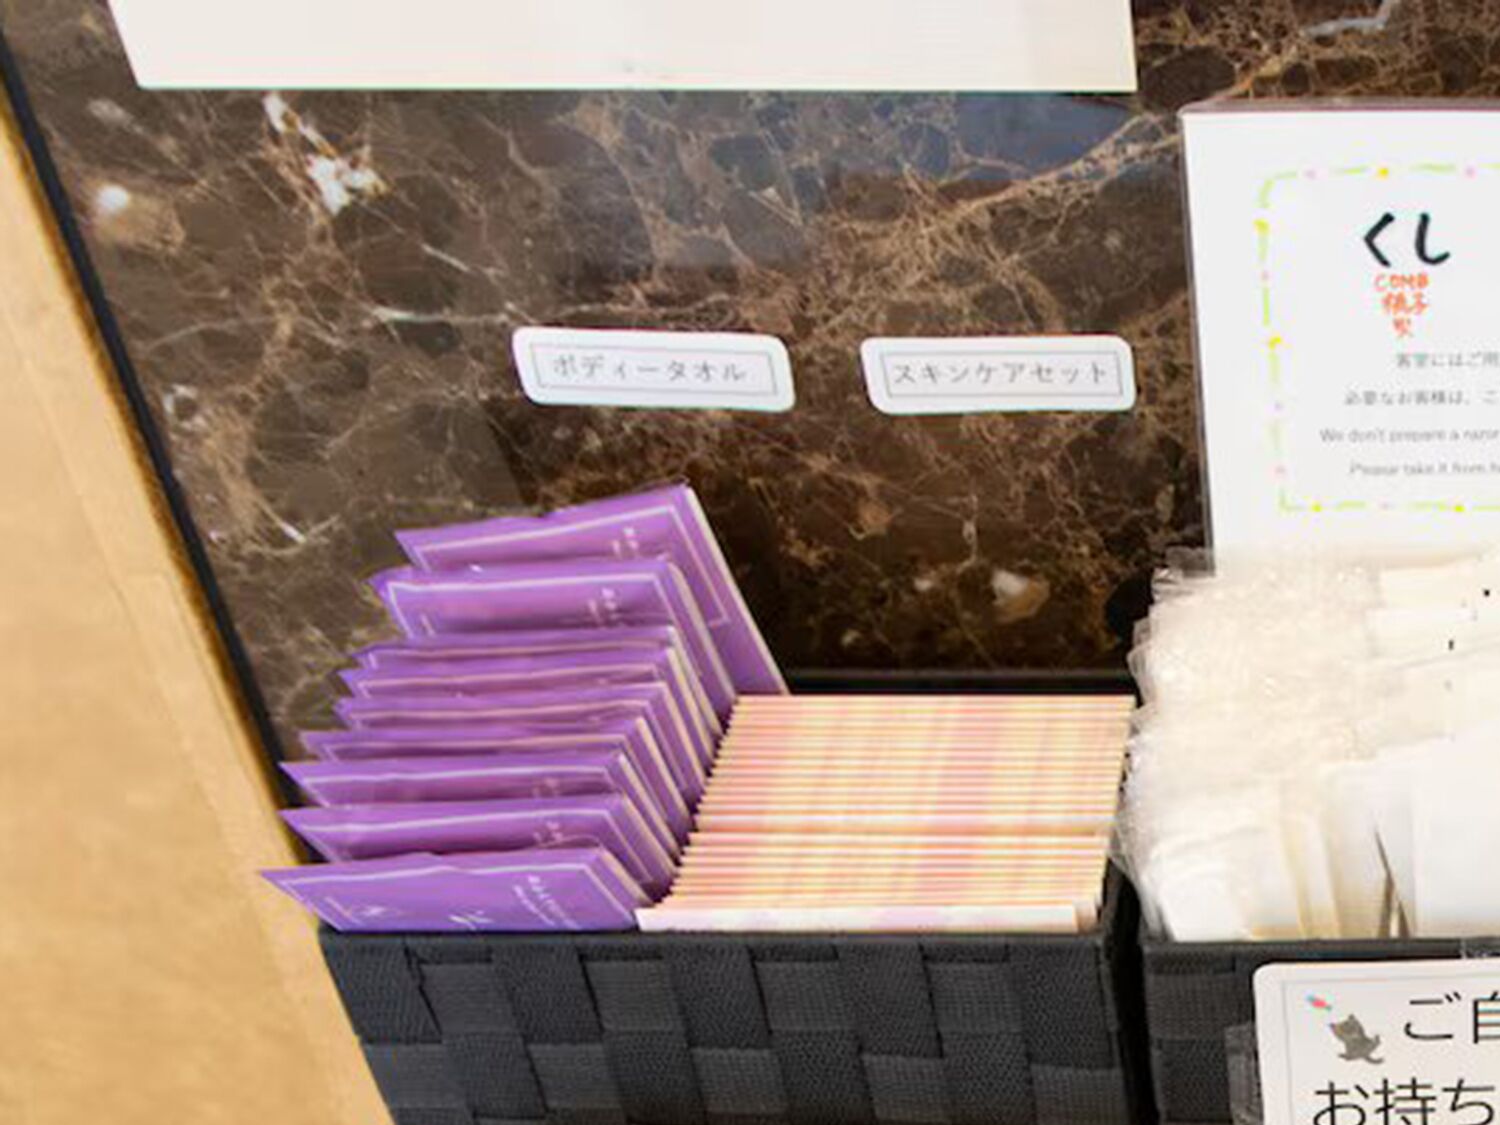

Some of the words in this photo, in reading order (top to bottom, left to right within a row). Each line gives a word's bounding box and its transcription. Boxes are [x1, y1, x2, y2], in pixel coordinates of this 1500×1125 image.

[1364, 213, 1451, 267] くし
[1374, 272, 1429, 291] COMB
[553, 355, 745, 383] ボディータオル
[893, 361, 1108, 386] スキンケアセット
[1319, 428, 1346, 443] We
[1389, 429, 1446, 446] prepare
[1463, 429, 1500, 440] razor
[1403, 461, 1435, 475] take
[1451, 461, 1487, 474] from
